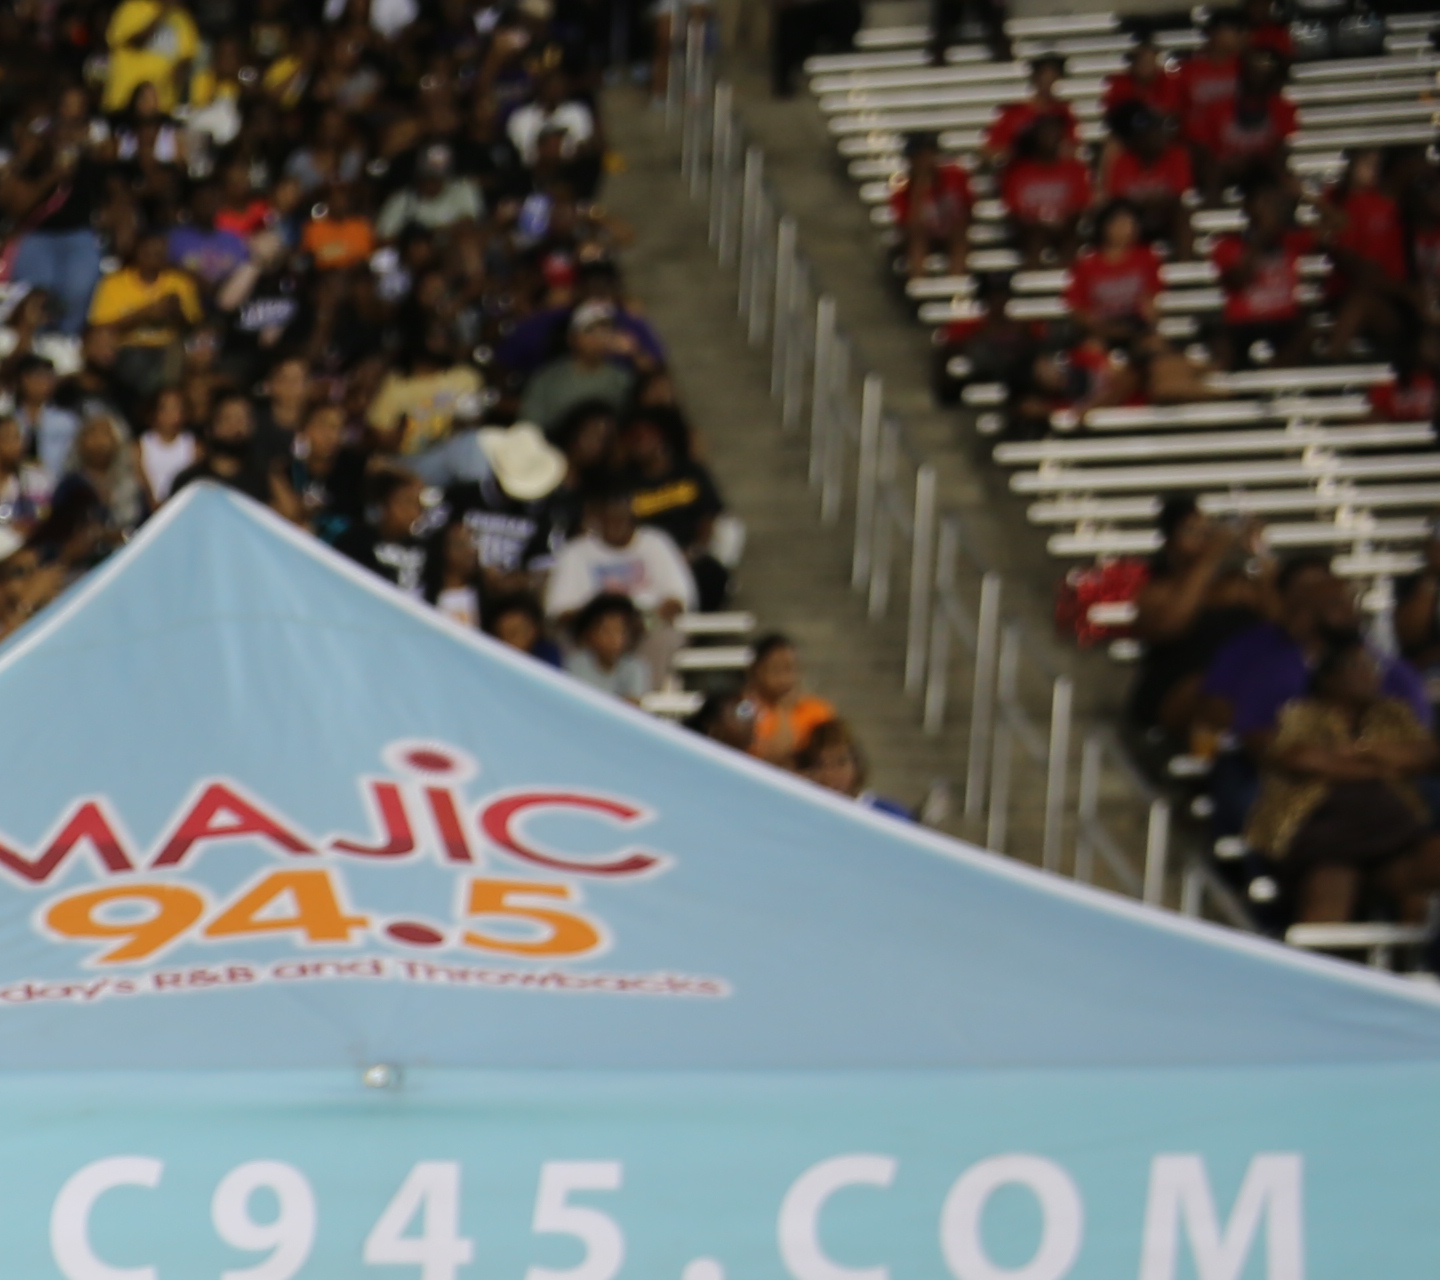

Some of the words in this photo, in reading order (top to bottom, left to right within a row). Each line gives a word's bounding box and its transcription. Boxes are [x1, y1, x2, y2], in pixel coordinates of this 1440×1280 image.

[42, 868, 601, 965] 94.5
[153, 964, 257, 991] R&B
[272, 956, 383, 983] and
[402, 958, 721, 998] Throwbacks
